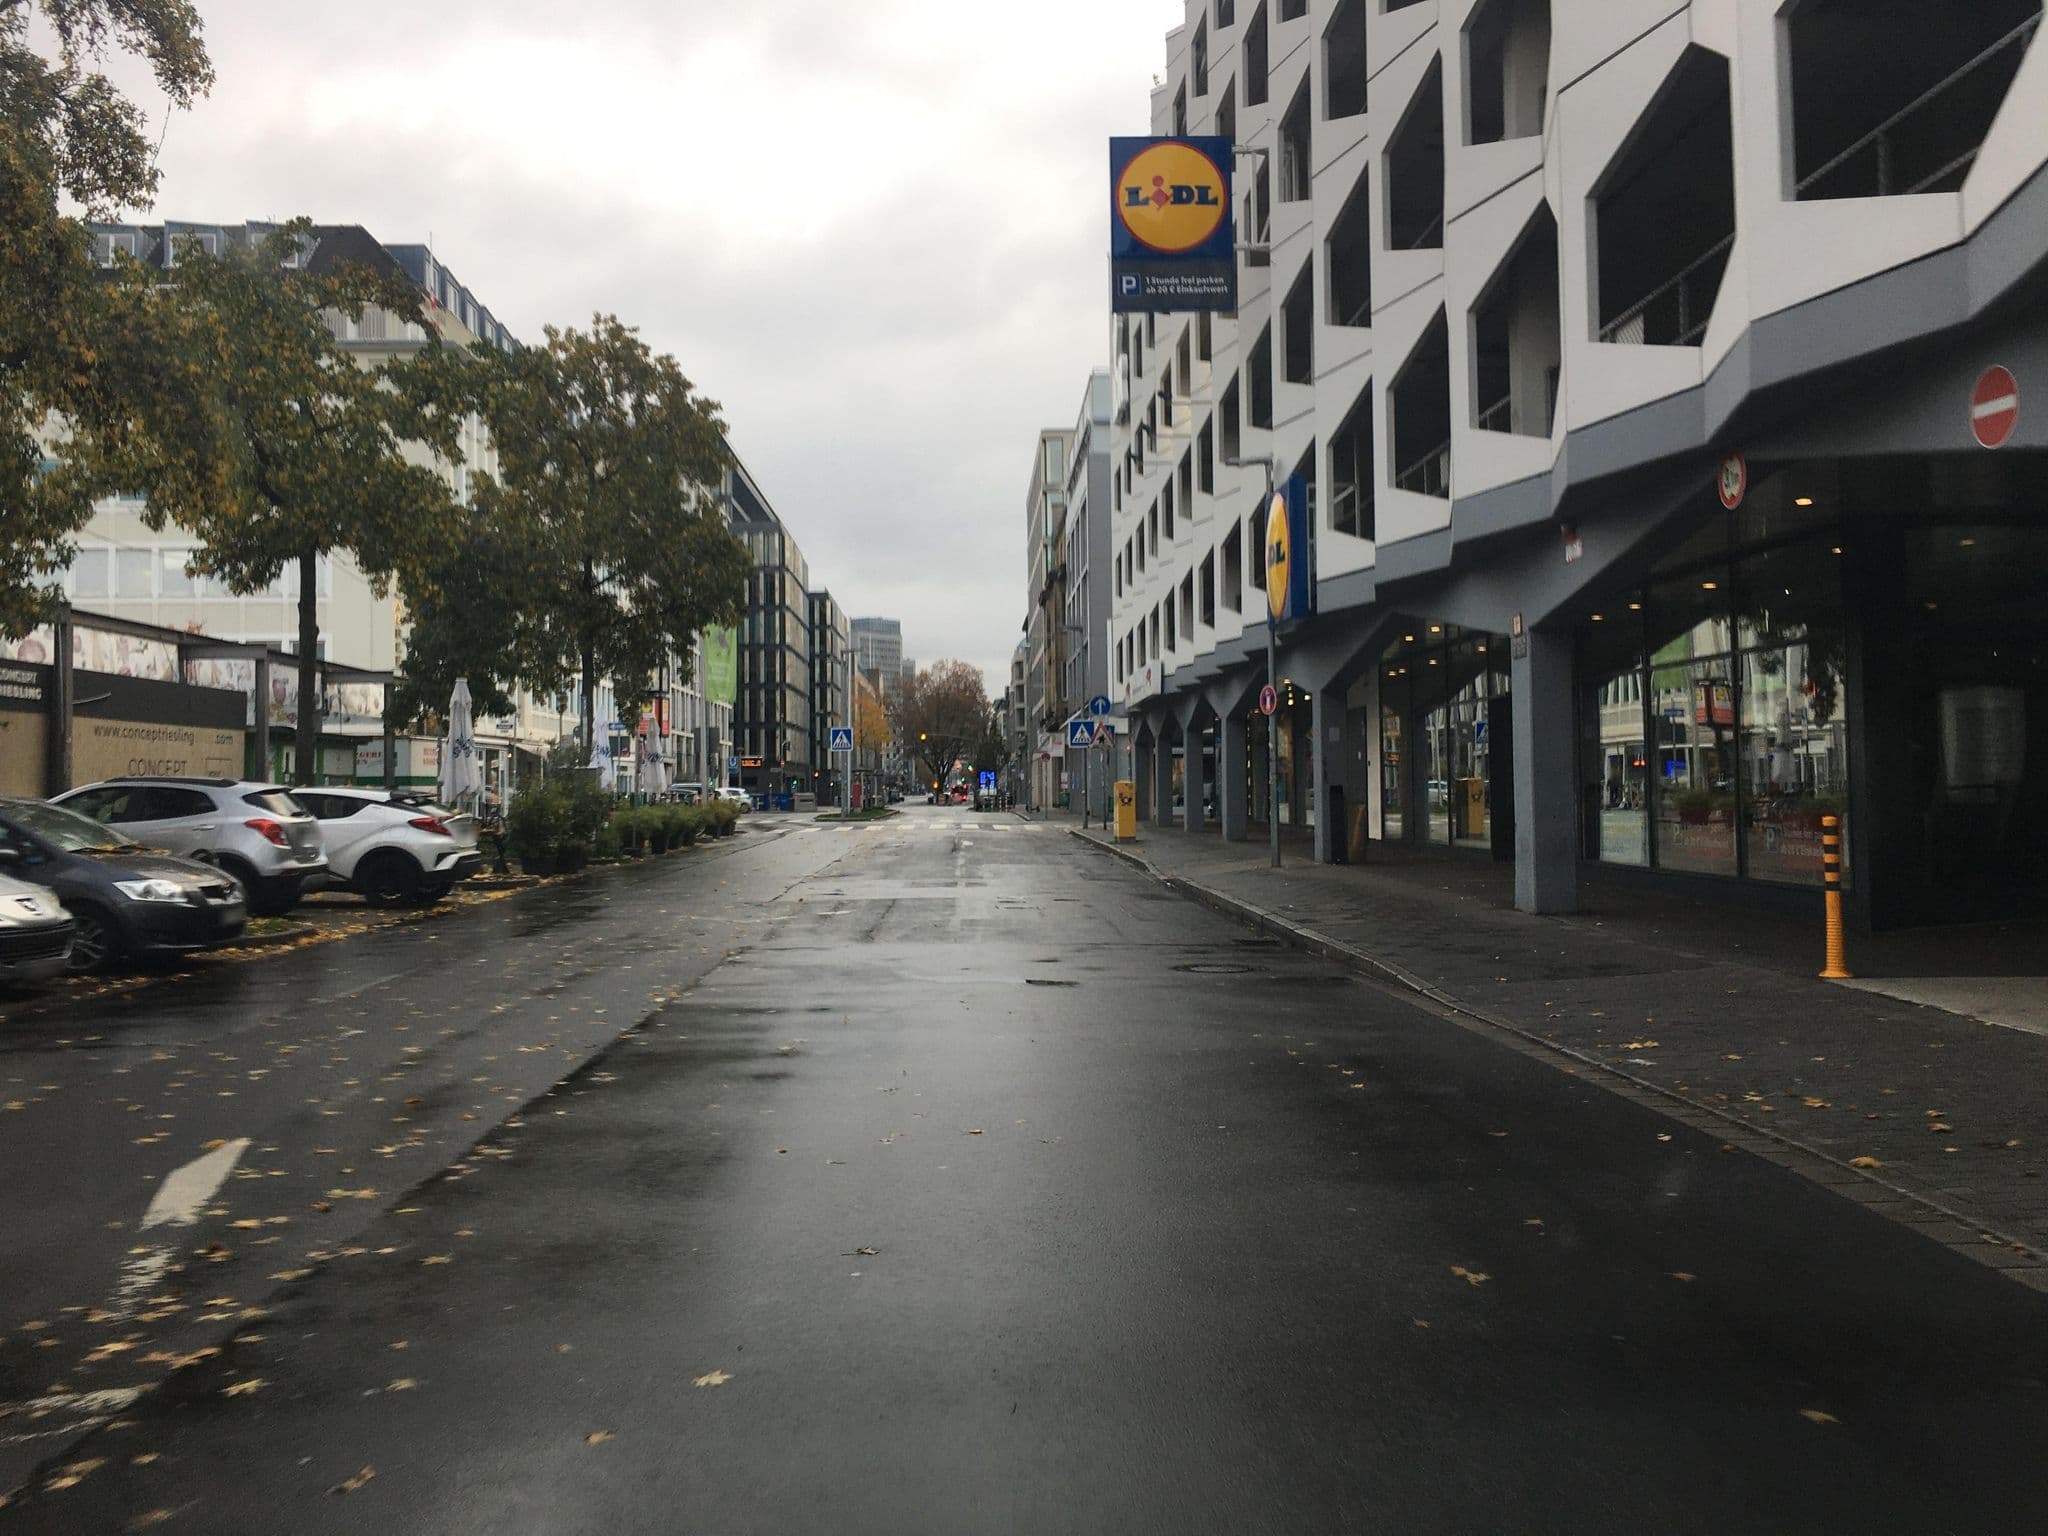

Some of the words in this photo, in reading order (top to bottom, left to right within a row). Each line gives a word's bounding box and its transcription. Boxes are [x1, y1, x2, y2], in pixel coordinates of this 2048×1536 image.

[1122, 276, 1137, 294] P
[1151, 276, 1180, 286] Stunde
[1196, 276, 1225, 287] parken
[1146, 285, 1156, 294] ab
[127, 757, 188, 777] CONCEPT
